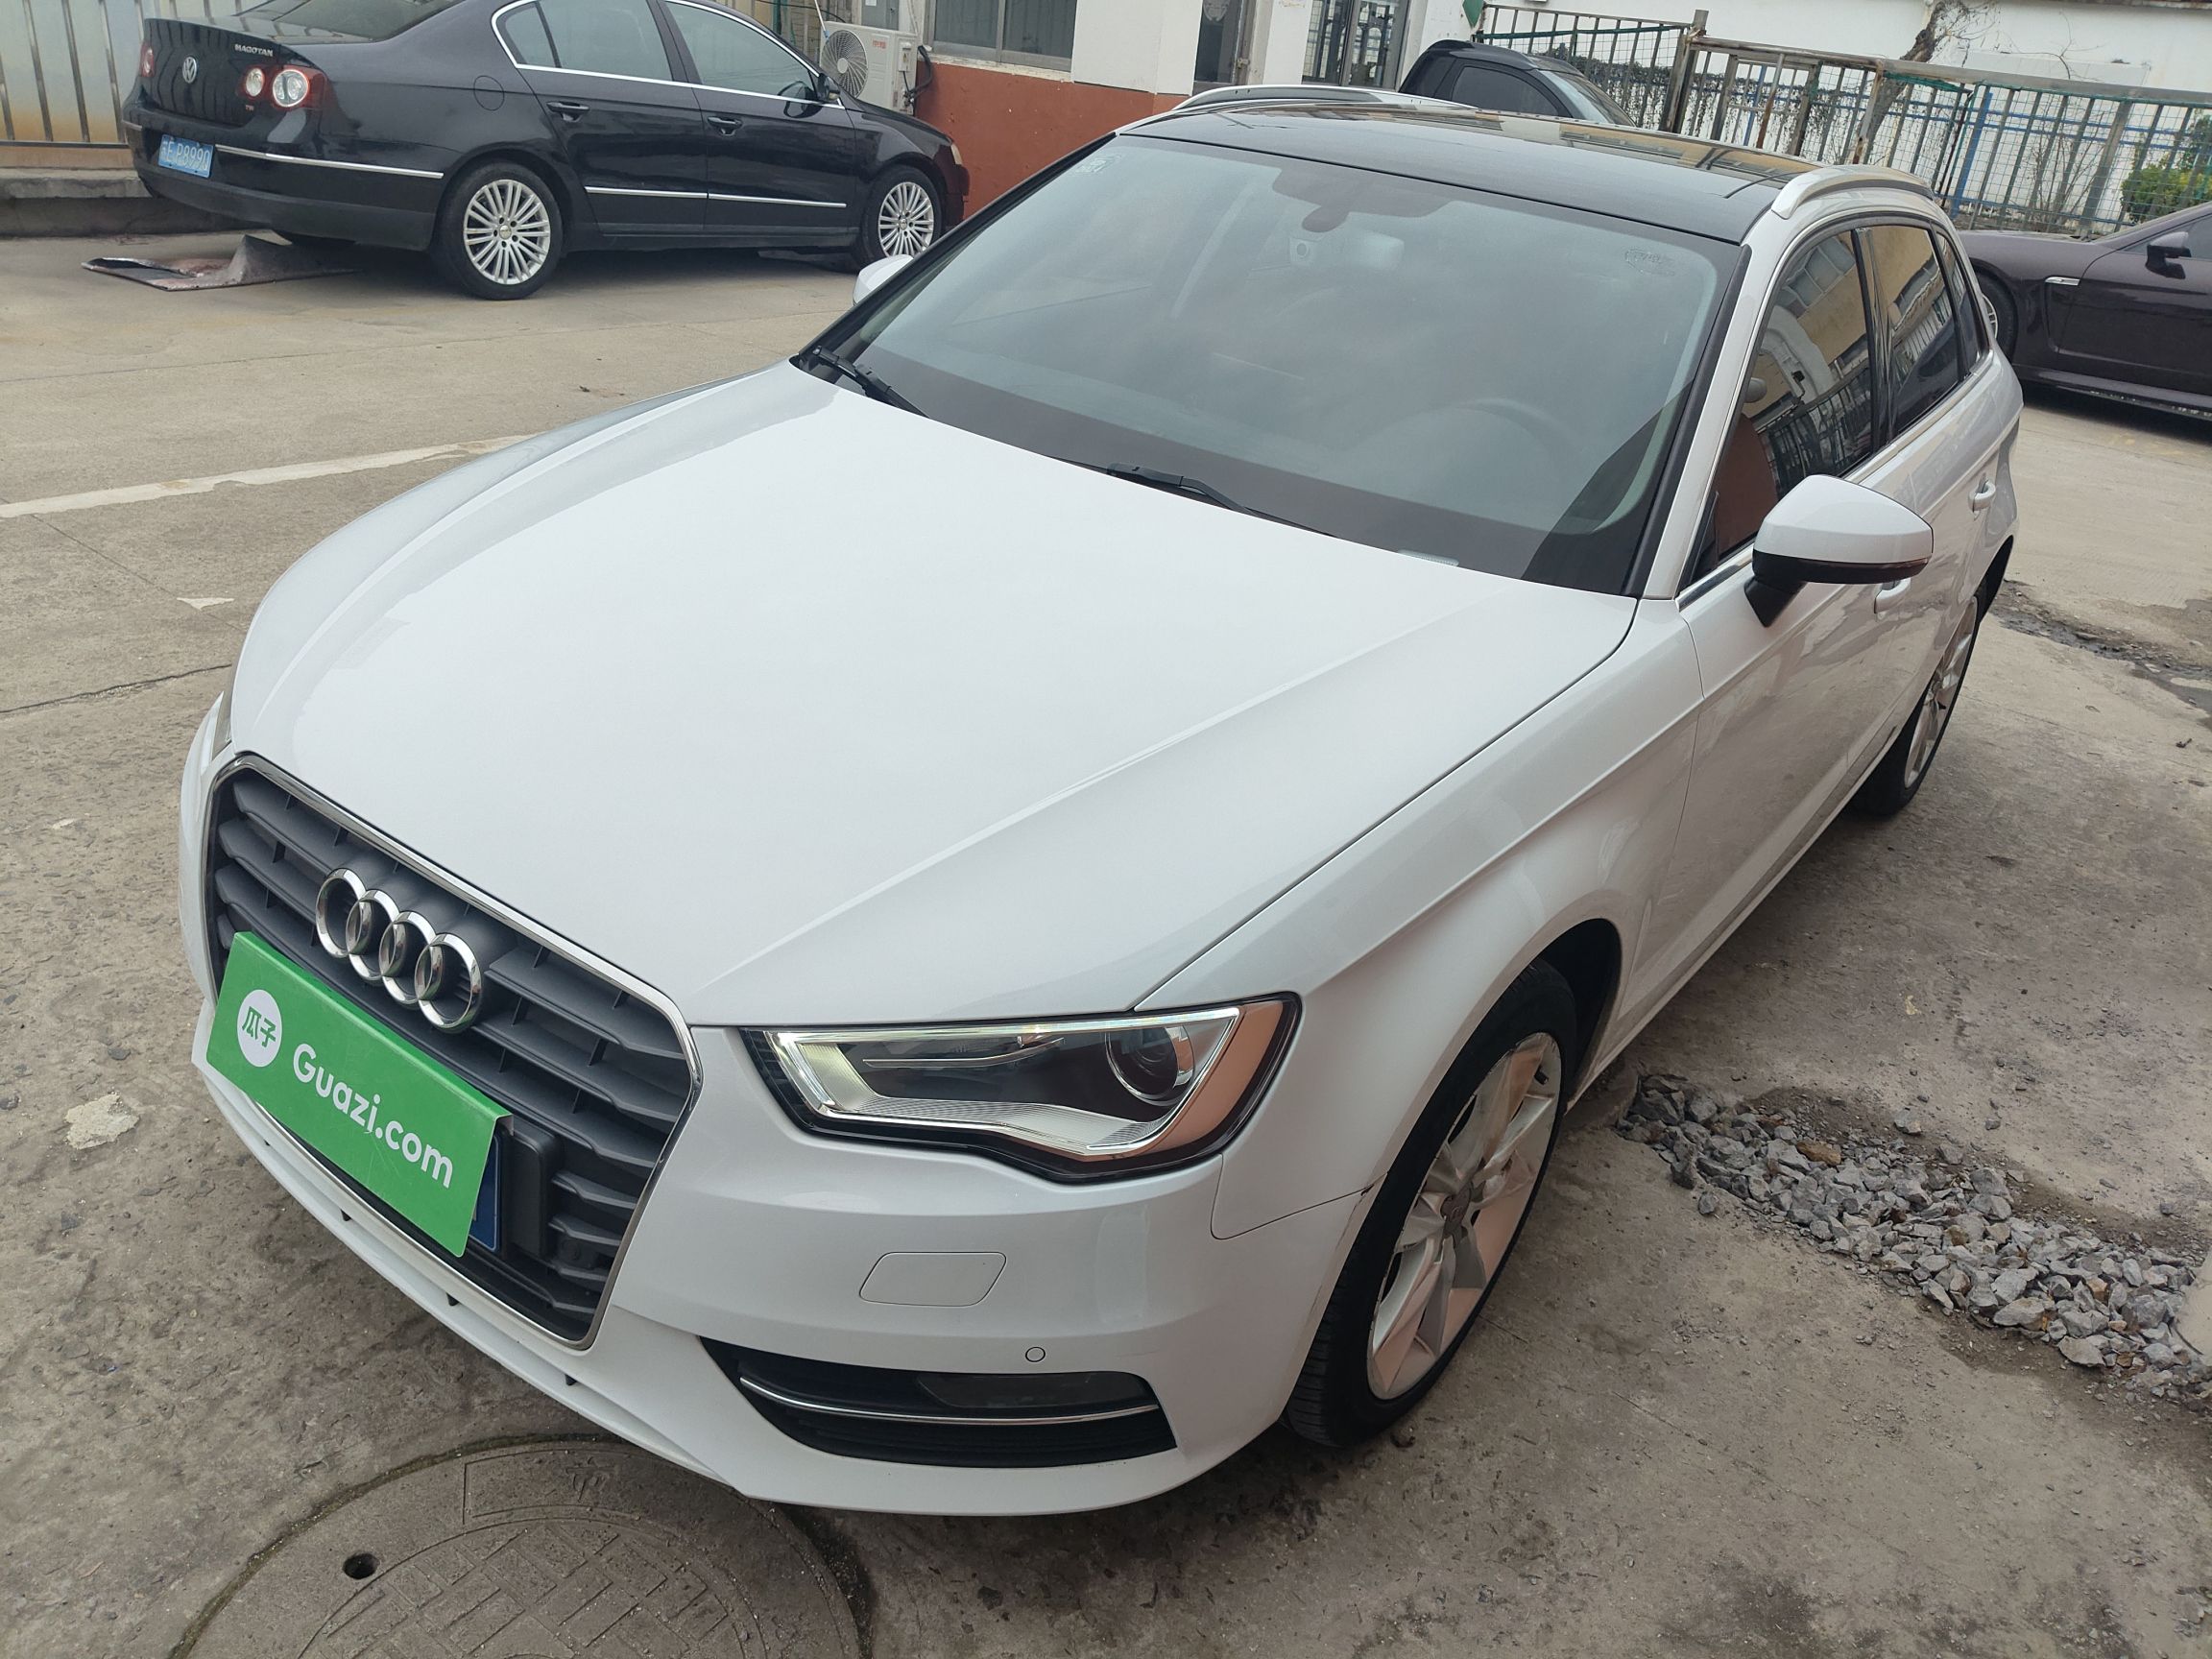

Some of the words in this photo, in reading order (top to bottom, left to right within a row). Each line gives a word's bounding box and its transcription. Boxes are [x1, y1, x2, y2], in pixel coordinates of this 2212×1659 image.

[234, 43, 274, 57] MAGOTAN
[241, 1005, 276, 1047] 瓜子
[293, 1043, 453, 1189] Guazi.com
